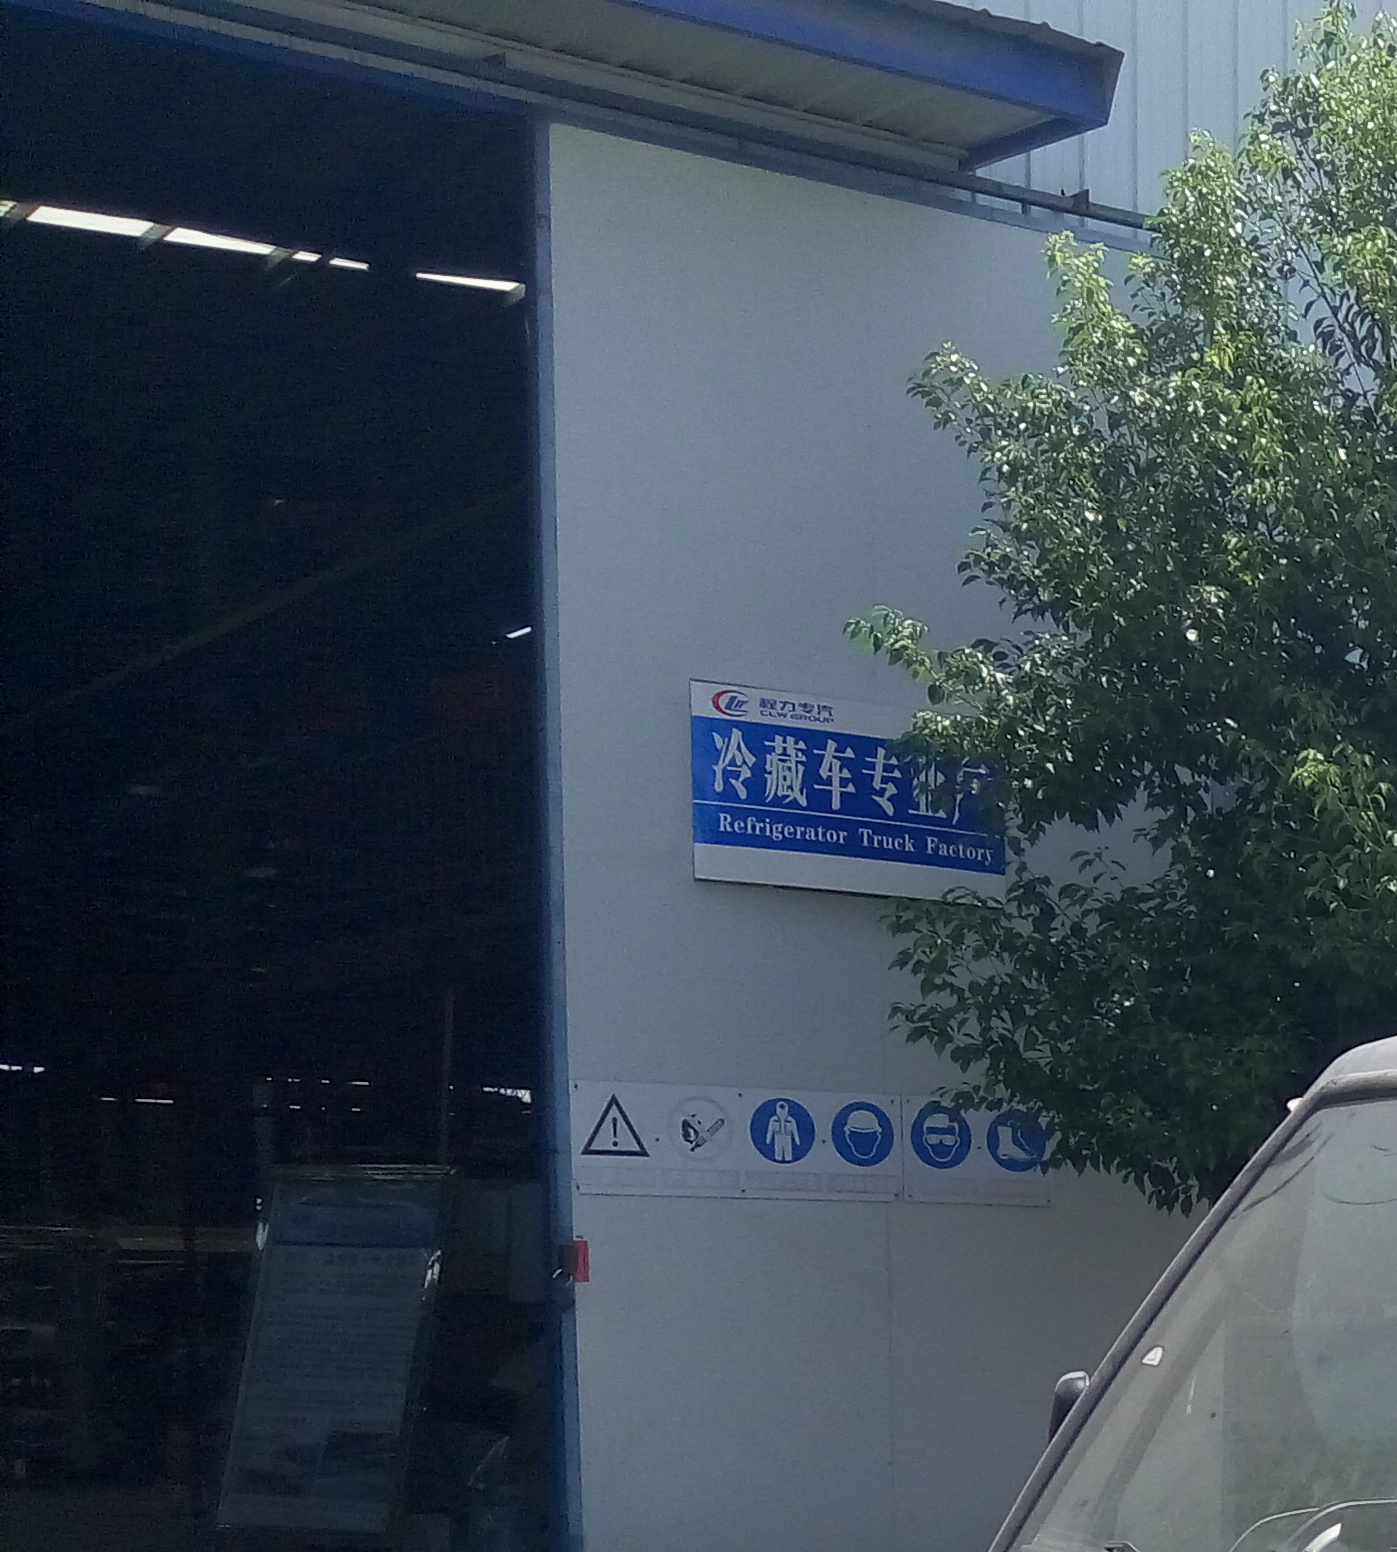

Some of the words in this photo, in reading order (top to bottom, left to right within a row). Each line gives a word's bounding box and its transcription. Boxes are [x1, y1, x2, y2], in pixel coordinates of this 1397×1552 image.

[759, 709, 788, 719] CLW
[790, 713, 835, 723] GROUP
[719, 813, 848, 844] Refrigerator
[858, 828, 916, 852] Truck
[926, 836, 993, 866] Factory
